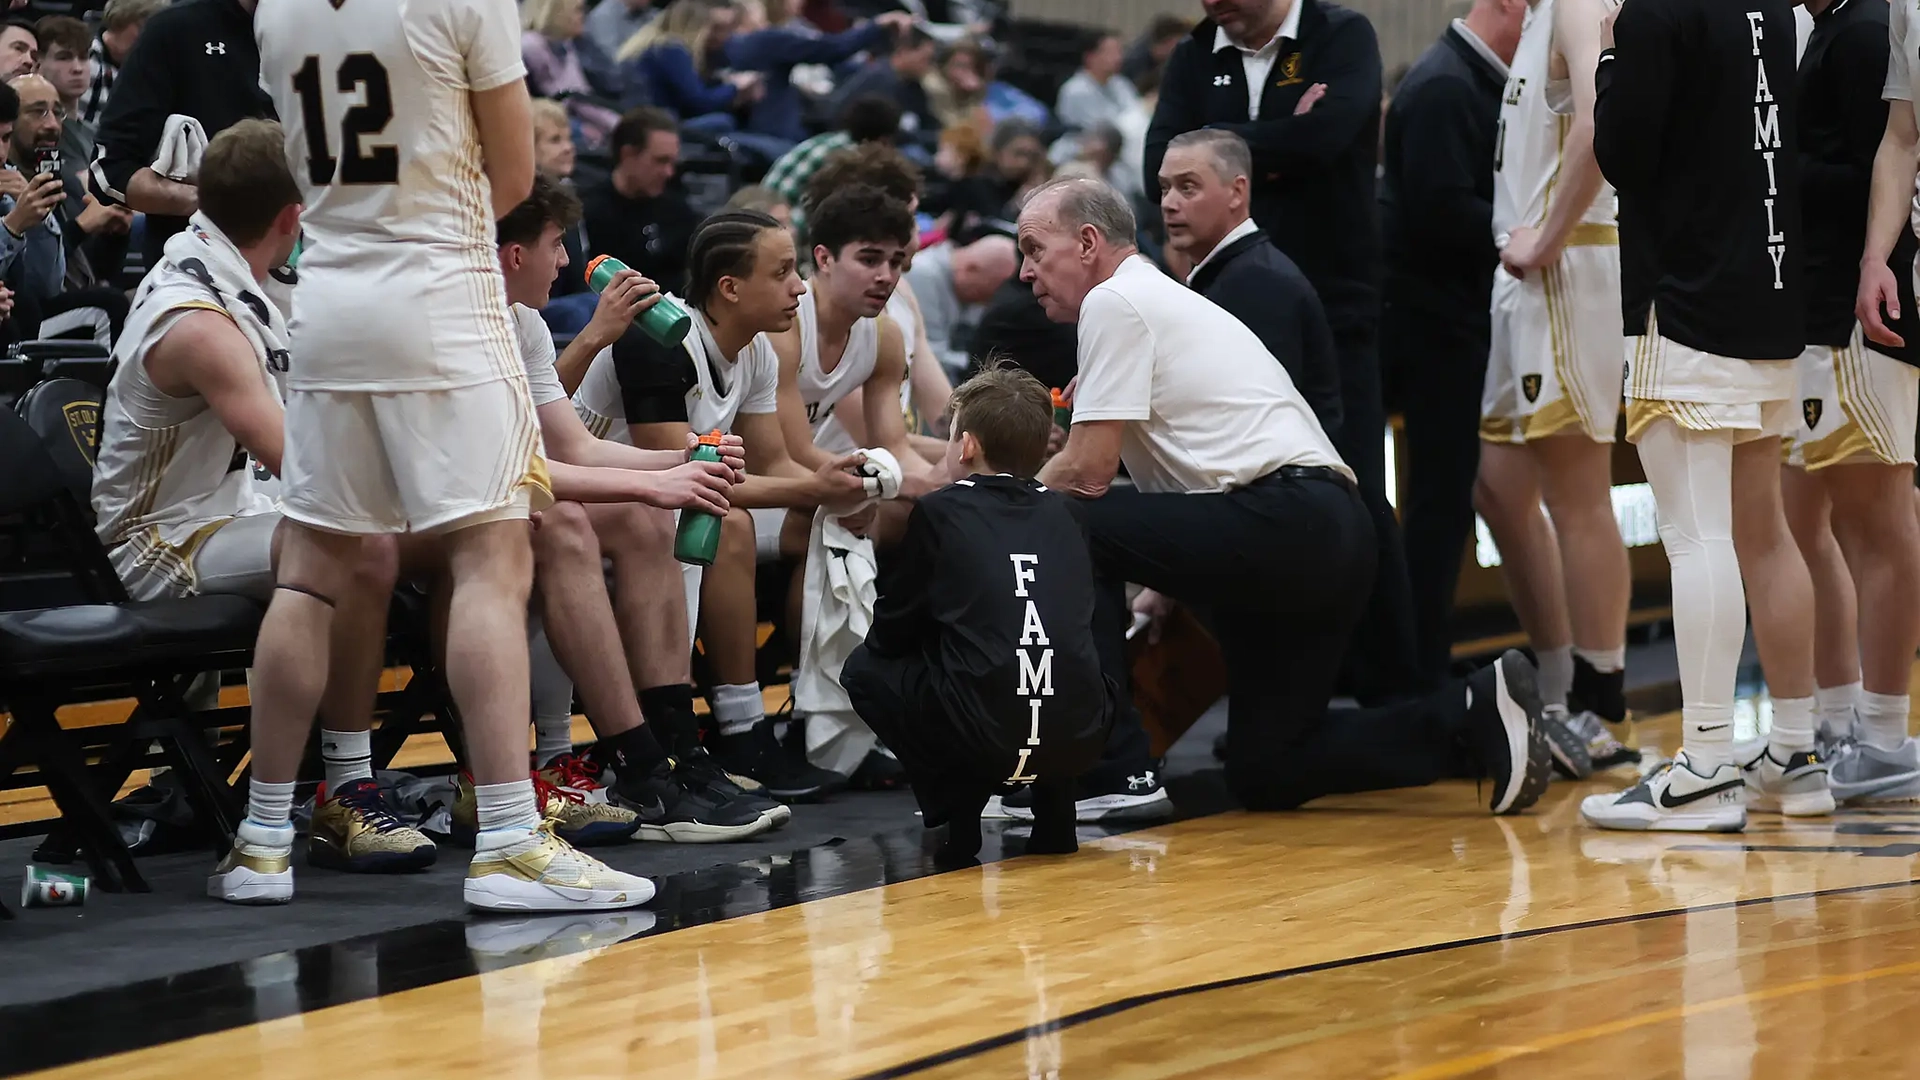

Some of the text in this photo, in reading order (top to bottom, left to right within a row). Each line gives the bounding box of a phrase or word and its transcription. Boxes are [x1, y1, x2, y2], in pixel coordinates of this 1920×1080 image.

[290, 51, 399, 187] 12
[1746, 11, 1785, 289] FAMILY
[1003, 554, 1054, 785] FAMIL
